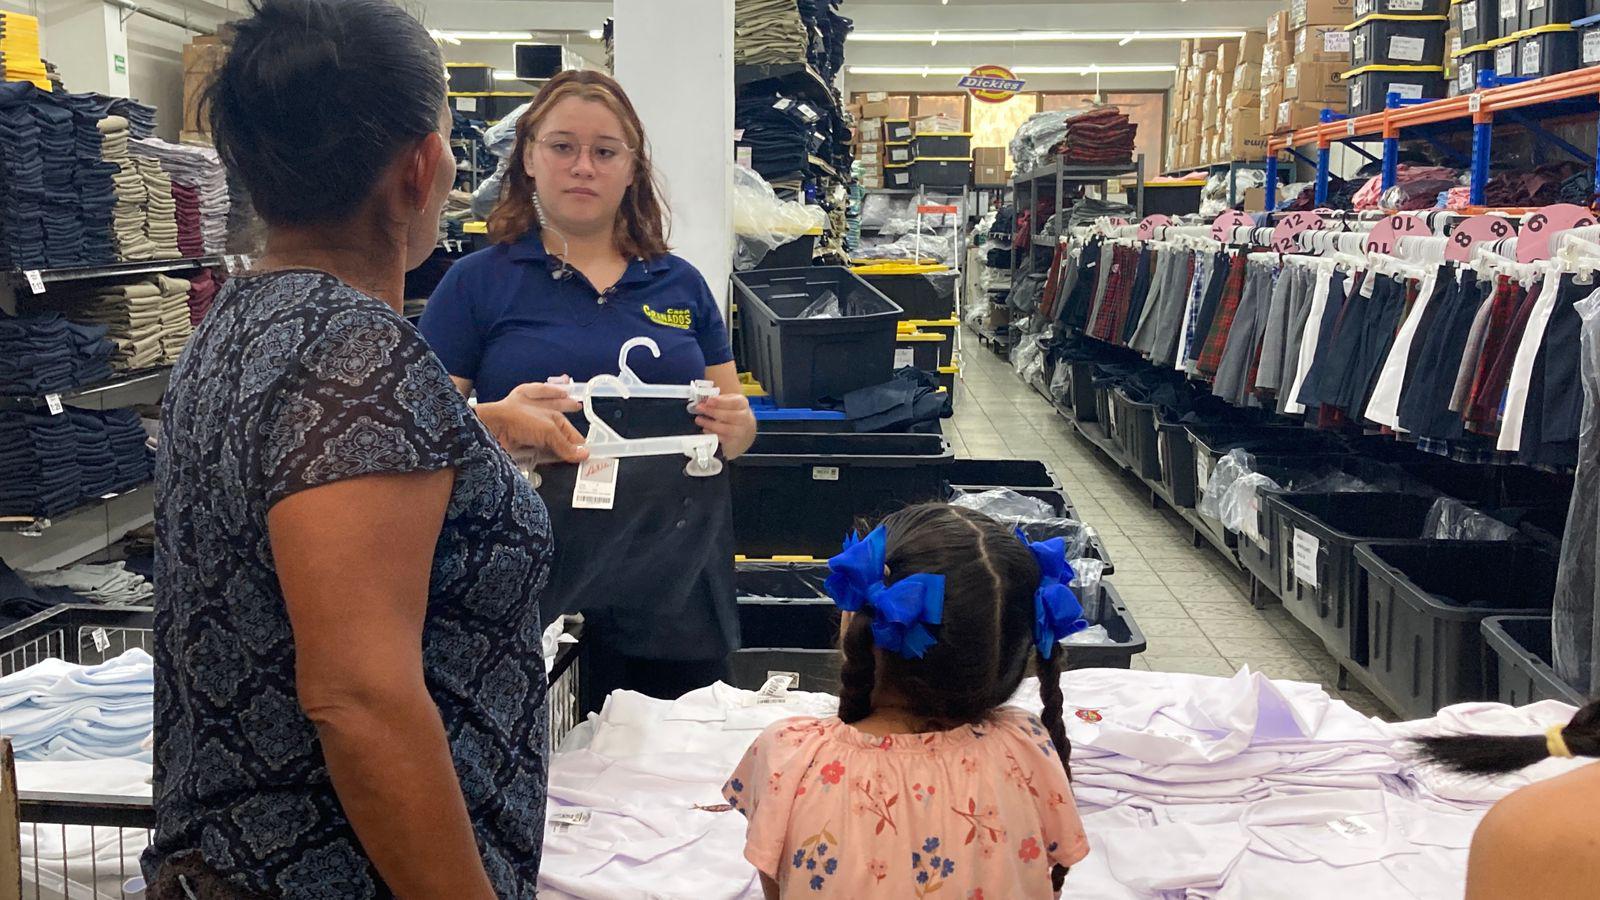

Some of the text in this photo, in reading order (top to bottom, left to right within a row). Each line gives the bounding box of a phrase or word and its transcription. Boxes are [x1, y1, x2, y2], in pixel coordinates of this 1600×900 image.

[964, 78, 1019, 90] Dickies
[1139, 219, 1153, 232] 16
[1284, 213, 1304, 230] 12
[1391, 216, 1415, 231] 10
[1490, 220, 1508, 238] 8
[1527, 213, 1548, 232] 6
[1271, 236, 1293, 252] 12
[1454, 231, 1472, 248] 8
[642, 304, 692, 325] GRANADOS
